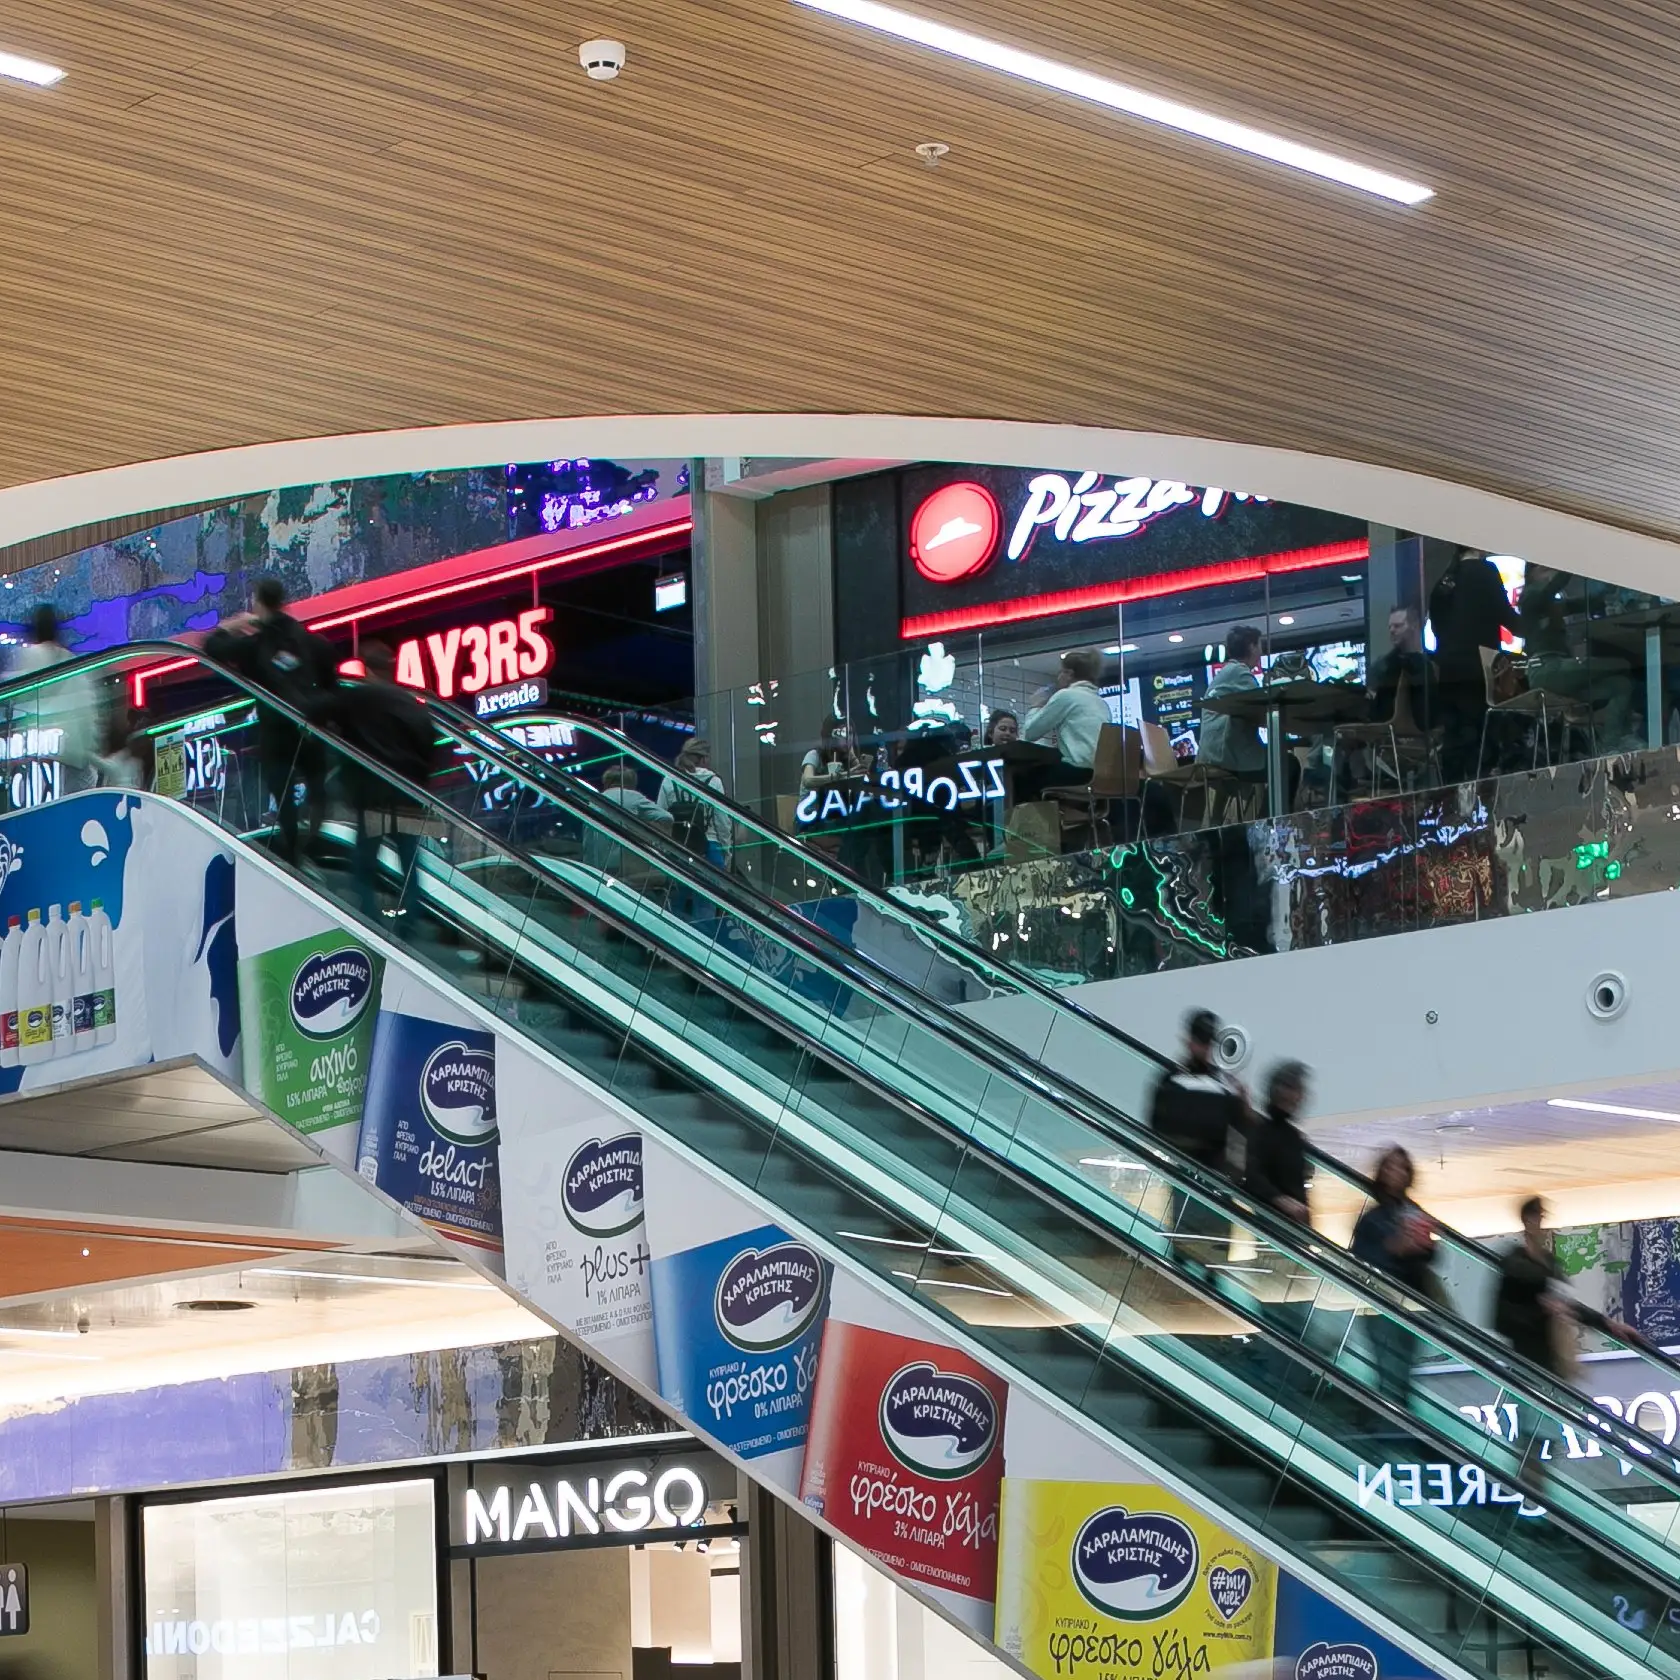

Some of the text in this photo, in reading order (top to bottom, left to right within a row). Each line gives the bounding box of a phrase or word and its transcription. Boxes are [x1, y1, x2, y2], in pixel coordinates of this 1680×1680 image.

[1007, 470, 1194, 560] Pizza
[338, 607, 554, 700] AY3R5
[476, 683, 540, 716] Arcade
[296, 962, 368, 1002] ΧΑΡΑΛΑΜΠΙΔΗΣ
[312, 978, 350, 1000] ΚΡΙΣΤΗΣ
[430, 1063, 495, 1090] ΧΑΡΑΛΑΜΠΙΔ
[301, 1085, 328, 1103] ΛΙΠΑΡΑ
[447, 1081, 488, 1101] ΚΡΙΣΤΗΣ
[418, 1141, 493, 1189] delact
[569, 1150, 643, 1193] ΧΑΡΑΛΑΜΠΙΔ
[589, 1168, 634, 1192] ΚΡΙΣΤΗΣ
[446, 1185, 476, 1205] ΛΙΠΑΡΑ
[580, 1244, 650, 1298] plus+
[724, 1261, 815, 1307] ΧΑΡΑΛΑΜΠΙΔΗΣ
[597, 1282, 641, 1305] 1% ΛΙΠΑΡΑ
[745, 1279, 793, 1305] ΚΡΙΣΤΗΣ
[706, 1362, 788, 1420] φρέσκο
[793, 1343, 819, 1393] γά
[754, 1393, 804, 1419] 0% ΛΙΠΑΡΑ
[891, 1386, 990, 1432] ΧΑΡΑΛΑΜΠΙΔΗΣ
[913, 1404, 965, 1431] ΚΡΙΣΤΗΣ
[466, 1467, 704, 1545] MANGO
[850, 1472, 937, 1522] φρέσκο
[942, 1491, 997, 1549] γάλα
[893, 1521, 945, 1550] 3% ΛΙΠΑΡΑ
[1082, 1528, 1190, 1564] ΧΑΡΑΛΑΜΠΙΔΗΣ
[865, 1546, 905, 1568] ΣΤΕΡΙΩΜΕΝΟ
[1107, 1547, 1163, 1567] ΚΡΙΣΤΗΣ
[1212, 1570, 1247, 1597] #my
[1217, 1590, 1240, 1606] Milk
[1055, 1617, 1090, 1630] ΚΥΠΡΙΑΚΟ
[1049, 1622, 1143, 1675] φρέσκο
[1300, 1653, 1373, 1677] ΧΑΡΑΛΑΜΠΙΔΗΣ
[1317, 1666, 1356, 1679] ΚΡΙΣΤΗΣ
